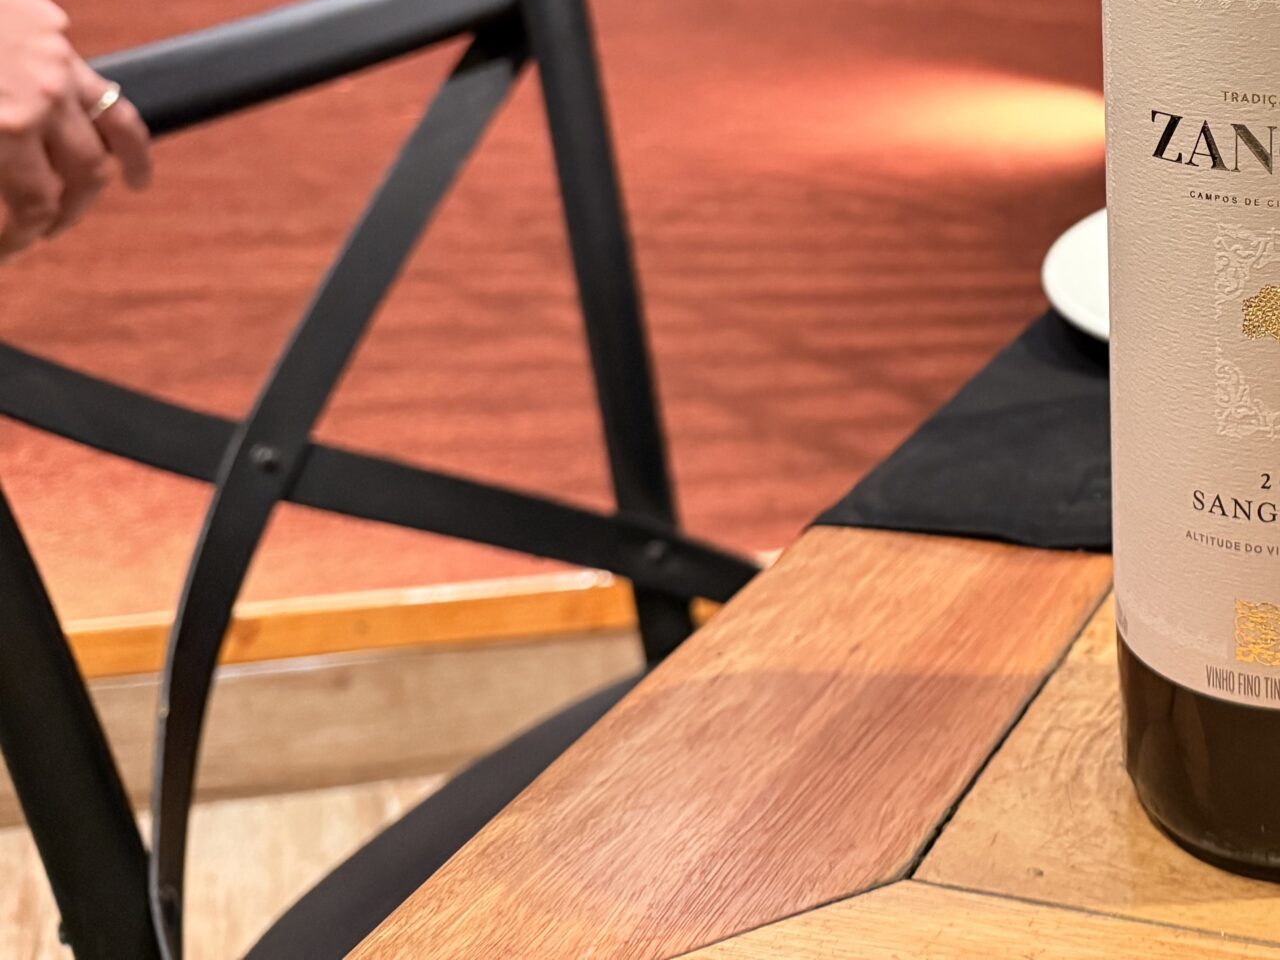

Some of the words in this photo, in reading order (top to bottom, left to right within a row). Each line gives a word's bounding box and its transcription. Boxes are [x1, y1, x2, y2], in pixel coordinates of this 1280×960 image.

[1188, 190, 1239, 205] CAMPOS
[1244, 197, 1260, 207] DE
[1185, 530, 1241, 551] ALTITUDE
[1244, 543, 1263, 554] DO
[1205, 664, 1235, 693] VINHO
[1237, 672, 1261, 698] FINO
